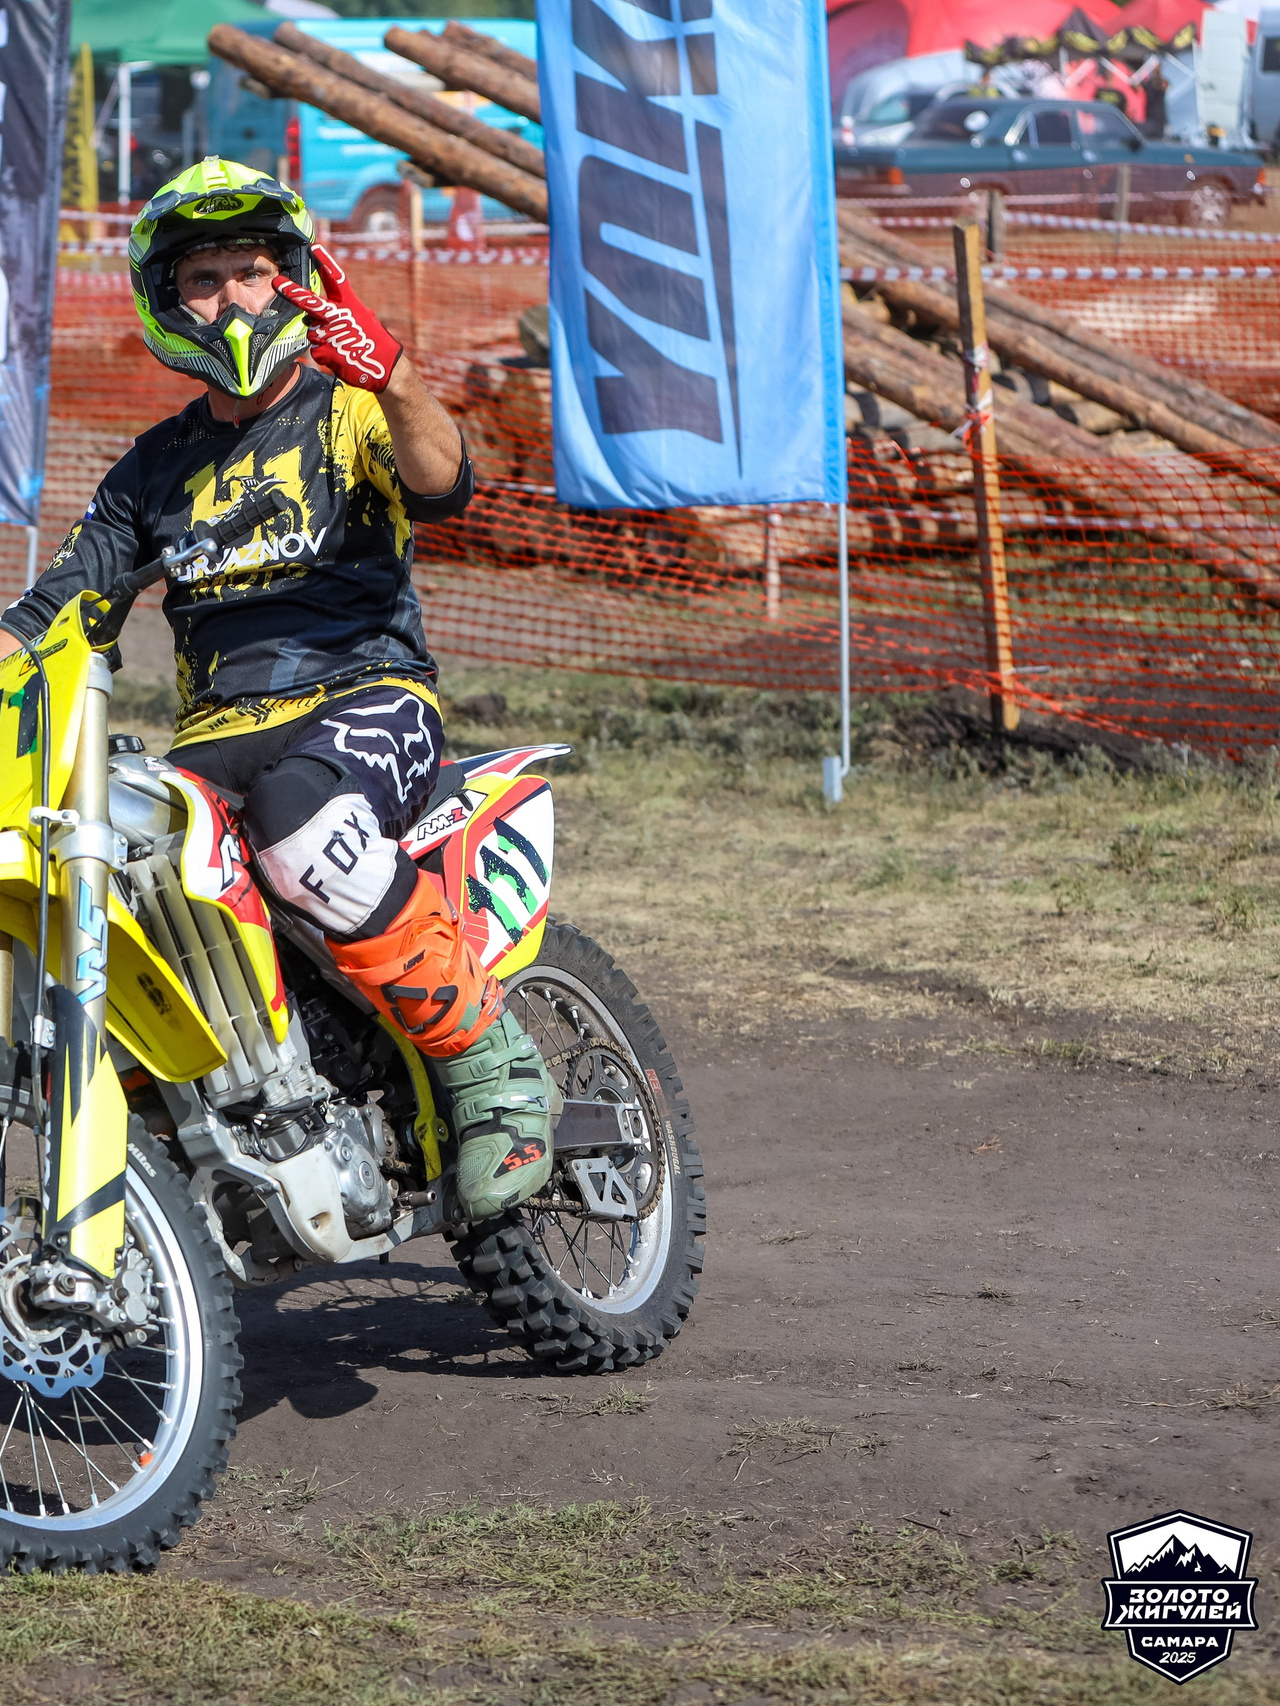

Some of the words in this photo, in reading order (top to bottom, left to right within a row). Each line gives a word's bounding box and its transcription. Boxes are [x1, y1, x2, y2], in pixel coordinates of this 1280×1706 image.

[417, 806, 468, 841] RM-Z
[298, 811, 371, 904] FOX
[465, 816, 551, 947] 111
[503, 1144, 543, 1171] 5.5
